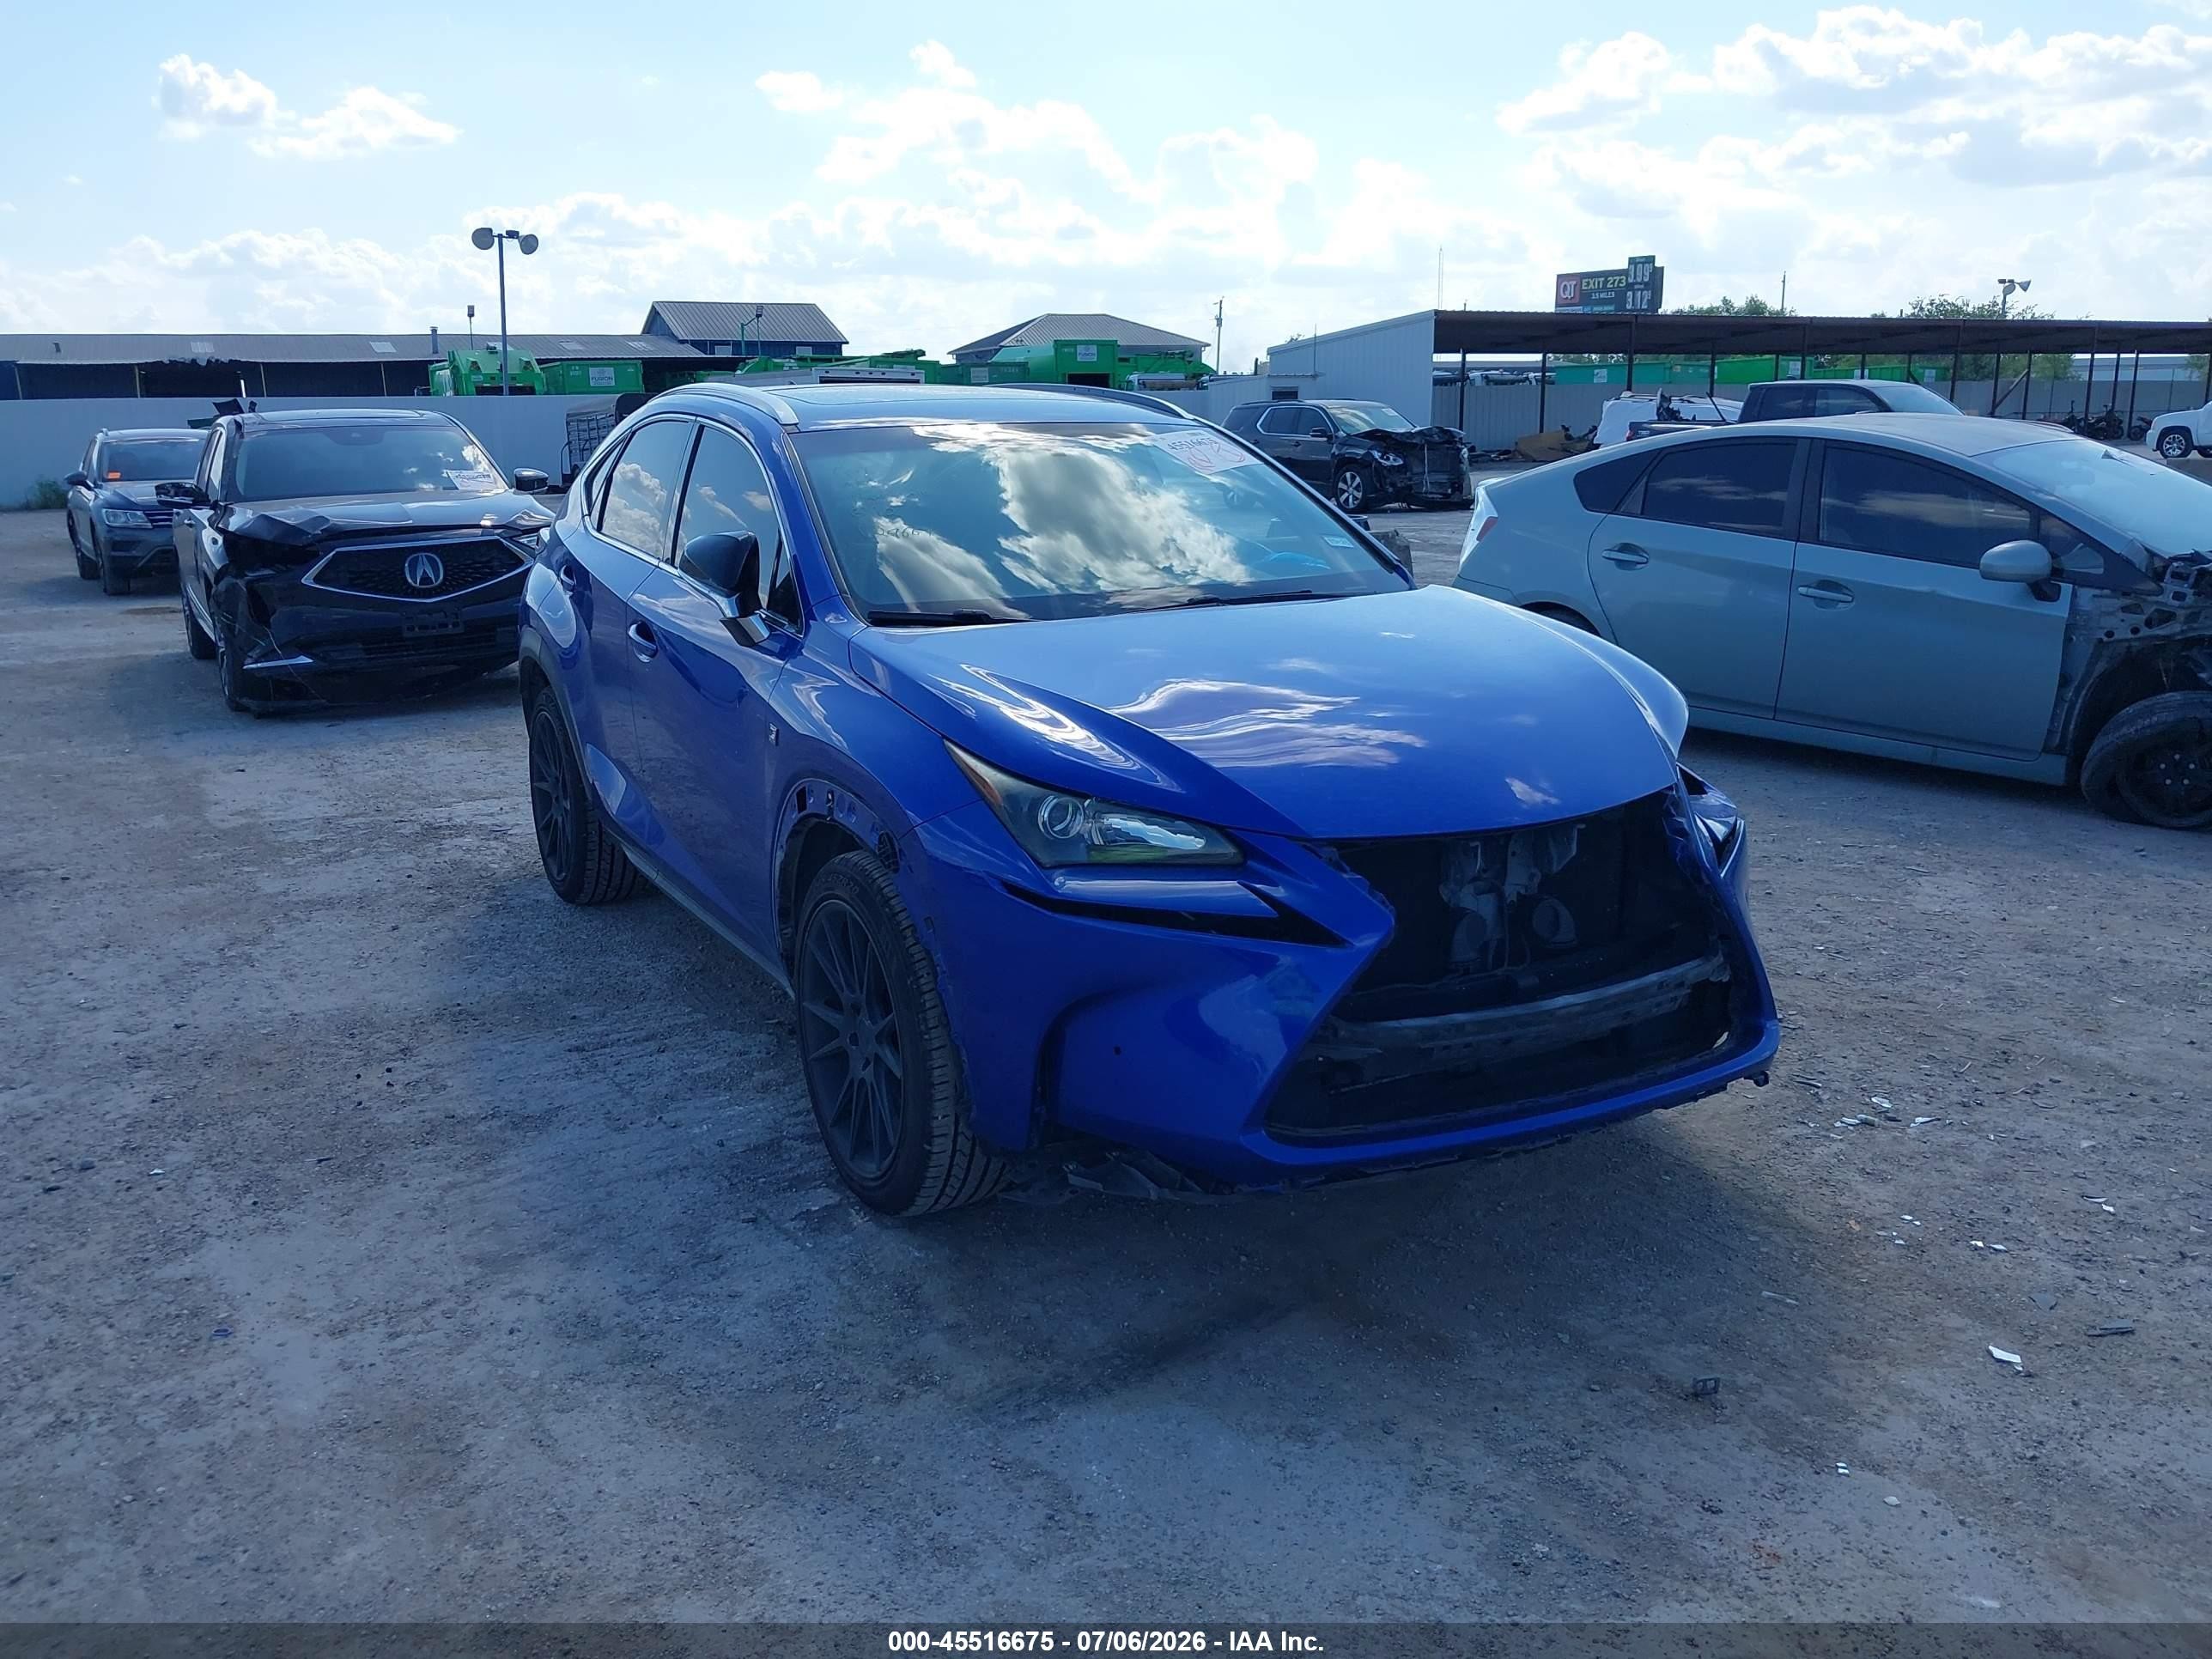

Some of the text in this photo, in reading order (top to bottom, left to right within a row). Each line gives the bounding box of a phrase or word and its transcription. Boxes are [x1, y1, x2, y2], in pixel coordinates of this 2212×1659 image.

[1582, 276, 1626, 289] EXIT 273
[1561, 282, 1577, 299] QT
